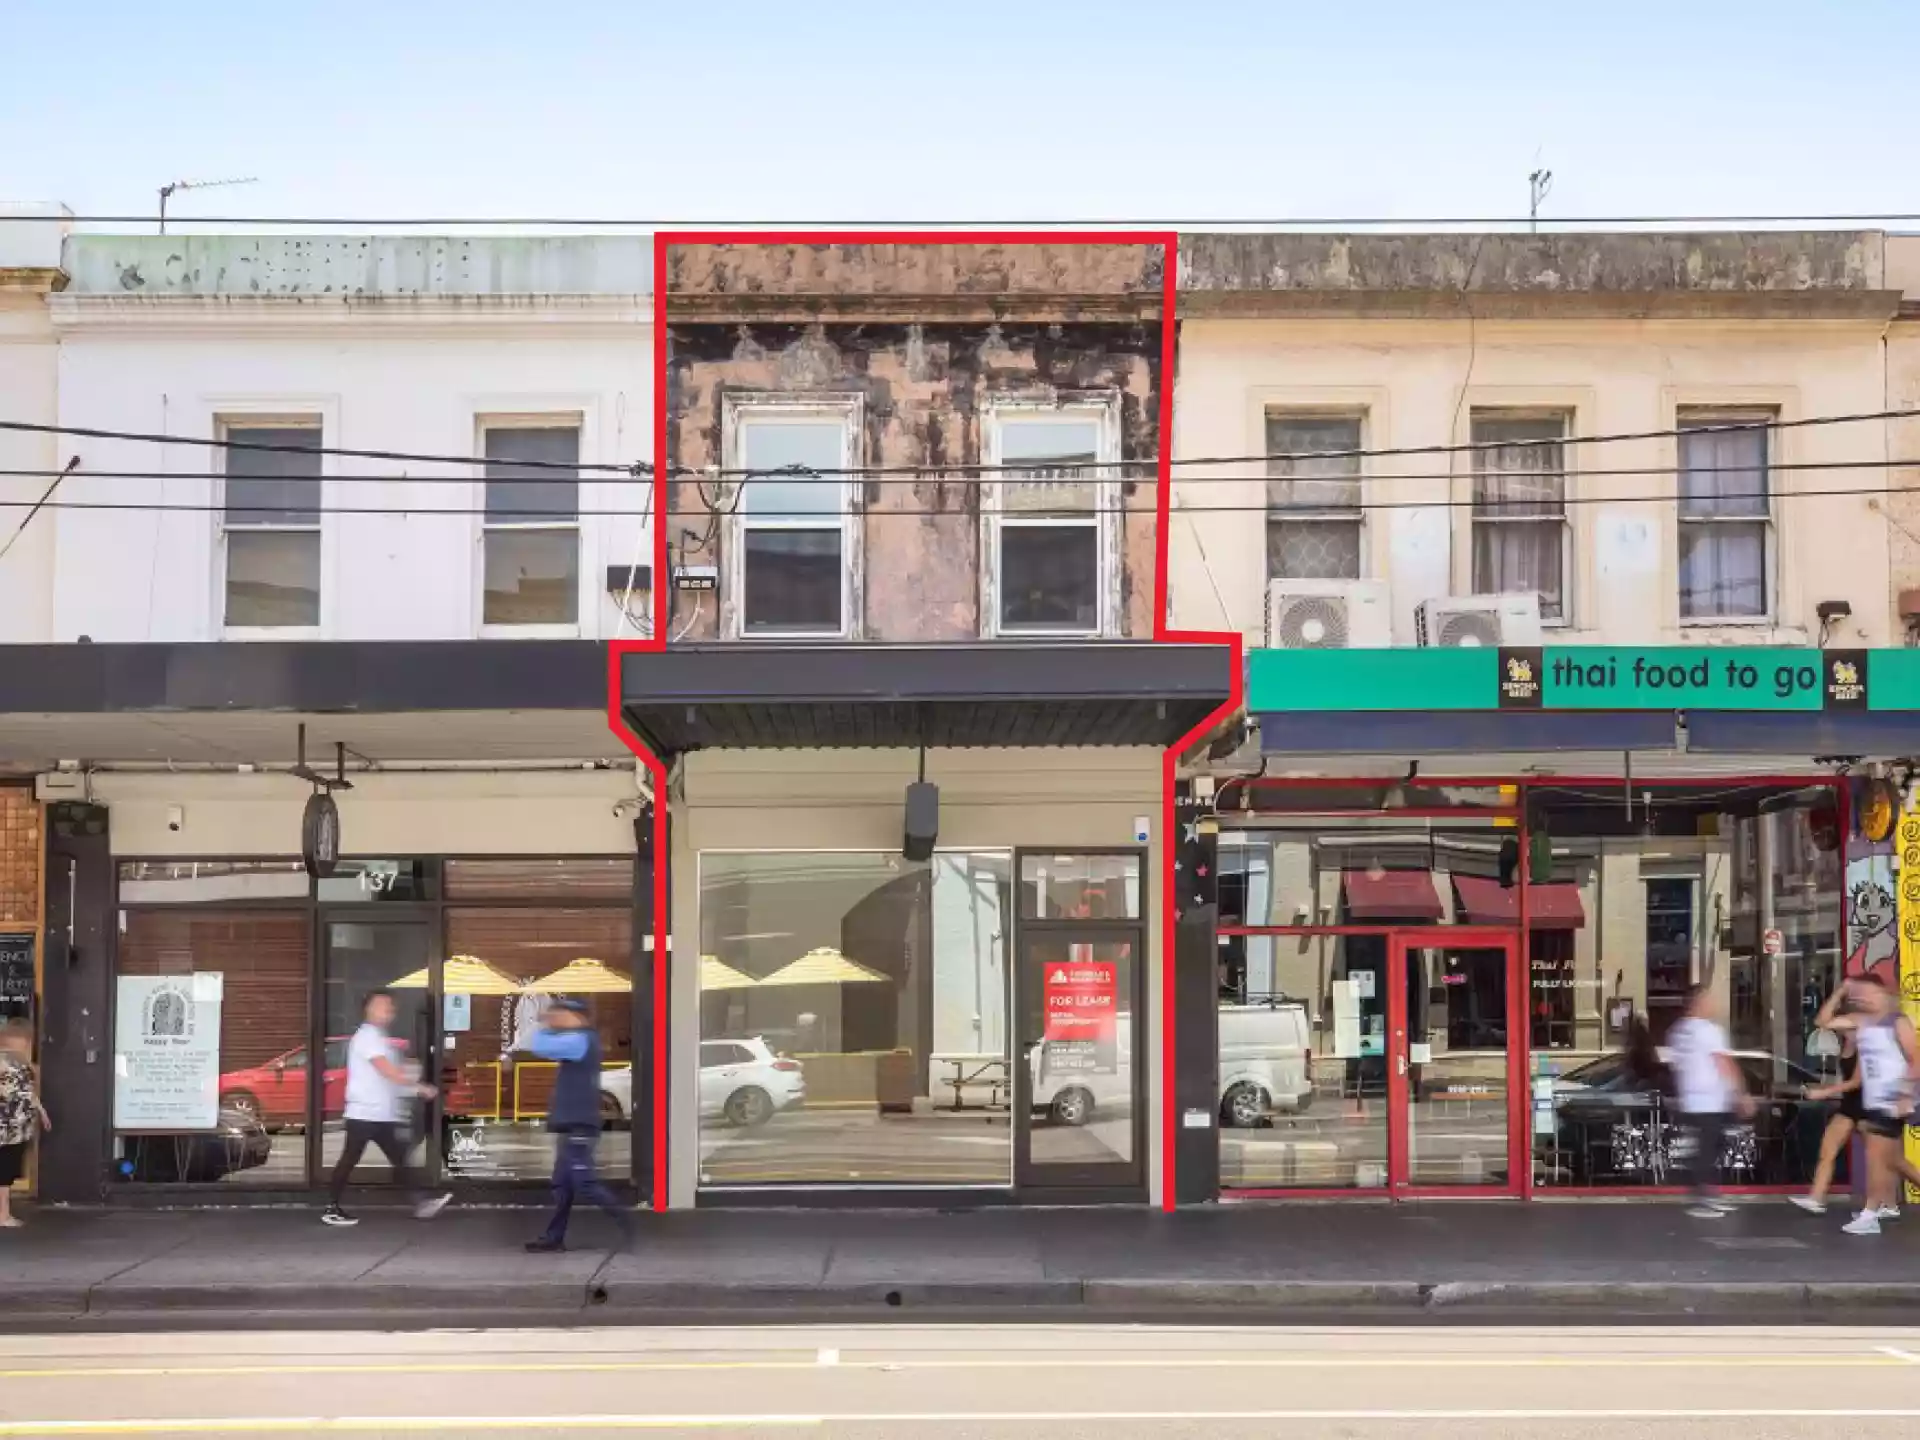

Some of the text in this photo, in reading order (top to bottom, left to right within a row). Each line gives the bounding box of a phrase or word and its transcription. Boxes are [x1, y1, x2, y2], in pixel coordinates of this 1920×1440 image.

[1552, 655, 1817, 699] thai food to go
[357, 869, 398, 892] 137
[1050, 996, 1073, 1006] FOR
